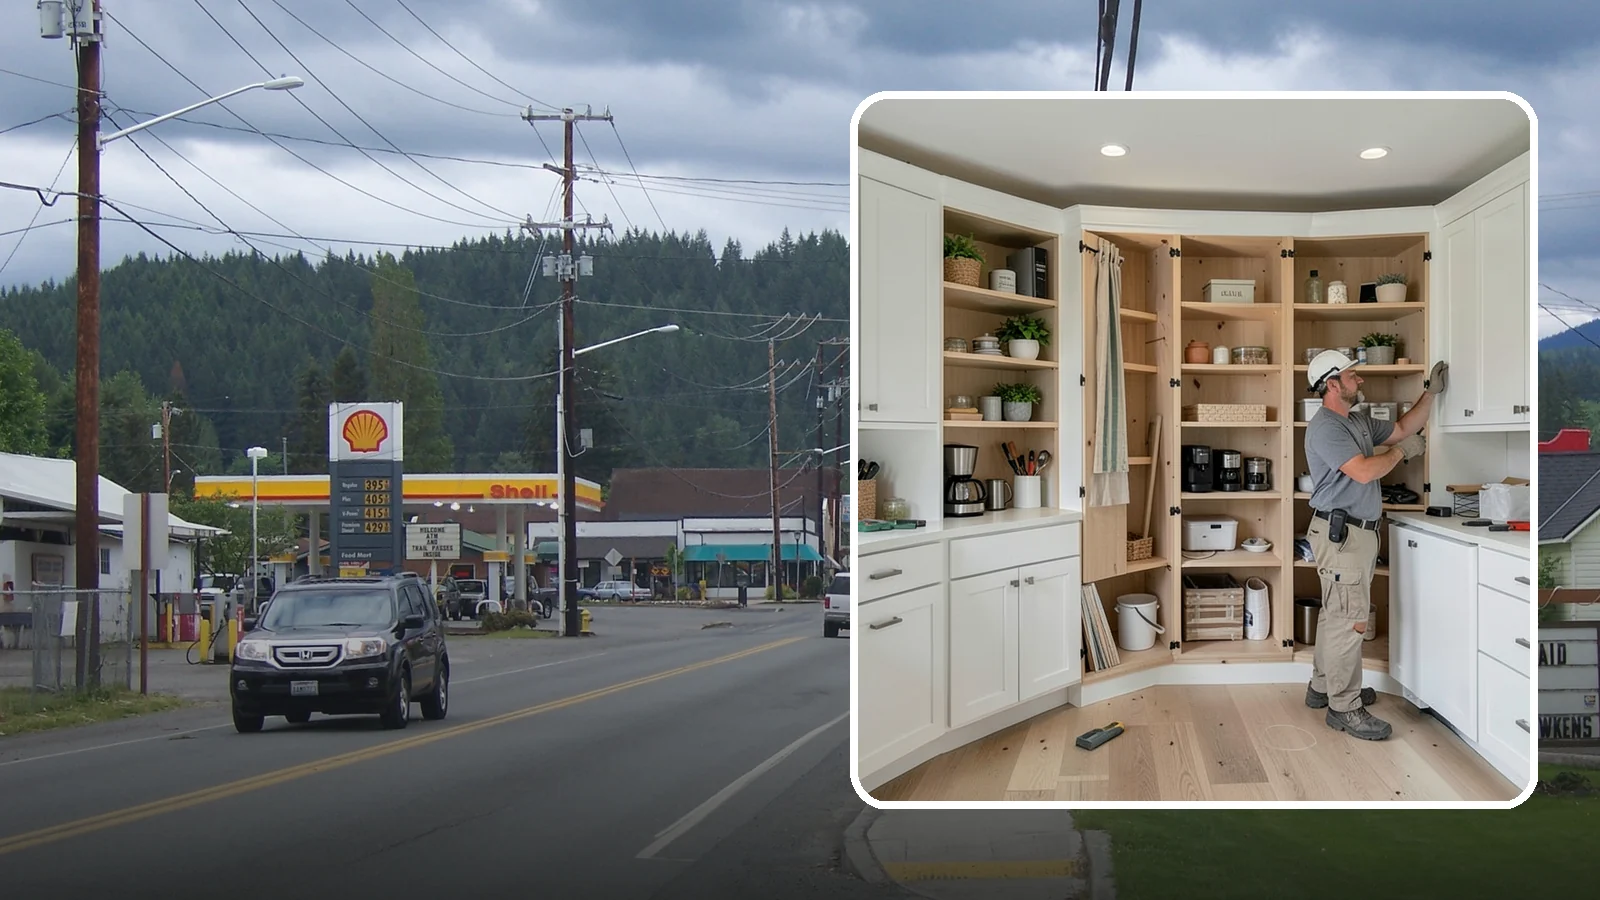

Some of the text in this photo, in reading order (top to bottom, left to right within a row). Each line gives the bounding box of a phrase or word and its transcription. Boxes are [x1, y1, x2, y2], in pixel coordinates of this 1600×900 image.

[366, 480, 383, 490] 395
[490, 484, 547, 499] Shell
[366, 494, 383, 504] 405
[366, 508, 383, 518] 415
[366, 522, 383, 533] 429
